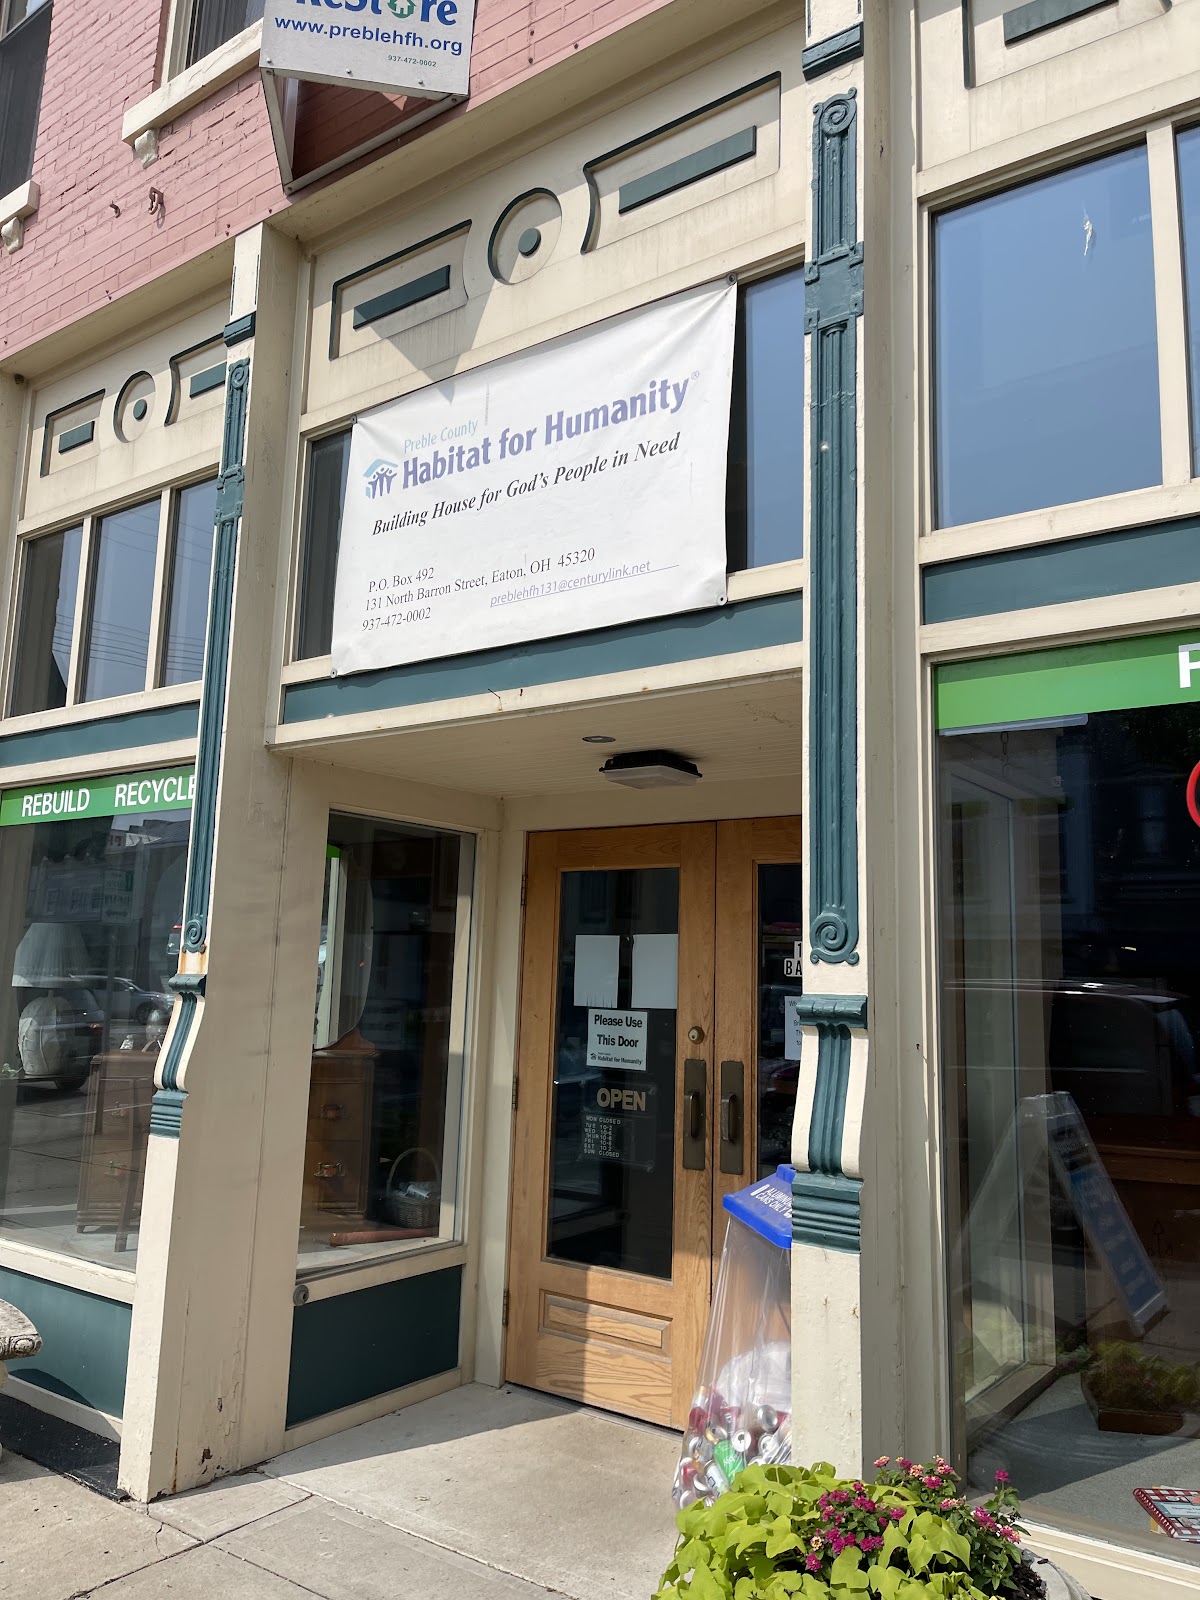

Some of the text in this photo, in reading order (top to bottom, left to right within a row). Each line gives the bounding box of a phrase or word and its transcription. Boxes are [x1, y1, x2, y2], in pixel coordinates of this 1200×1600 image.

[274, 17, 463, 56] www.preblehfh.org
[404, 419, 479, 454] Preble County
[402, 436, 492, 490] Habitat
[499, 427, 538, 460] for
[372, 431, 681, 536] Building House for God’s People in Need
[365, 547, 596, 611] 131 North Barron Street, Eaton, OH 45320
[368, 567, 435, 593] P.O. Box 492
[490, 560, 652, 606] preblehfh131@centurylink.net
[362, 606, 431, 631] 937-472-0002
[21, 788, 91, 817] REBUILD
[594, 1014, 643, 1028] Please Use
[596, 1034, 640, 1048] This Door
[596, 1087, 646, 1111] OPEN
[599, 1117, 621, 1125] CLOSED
